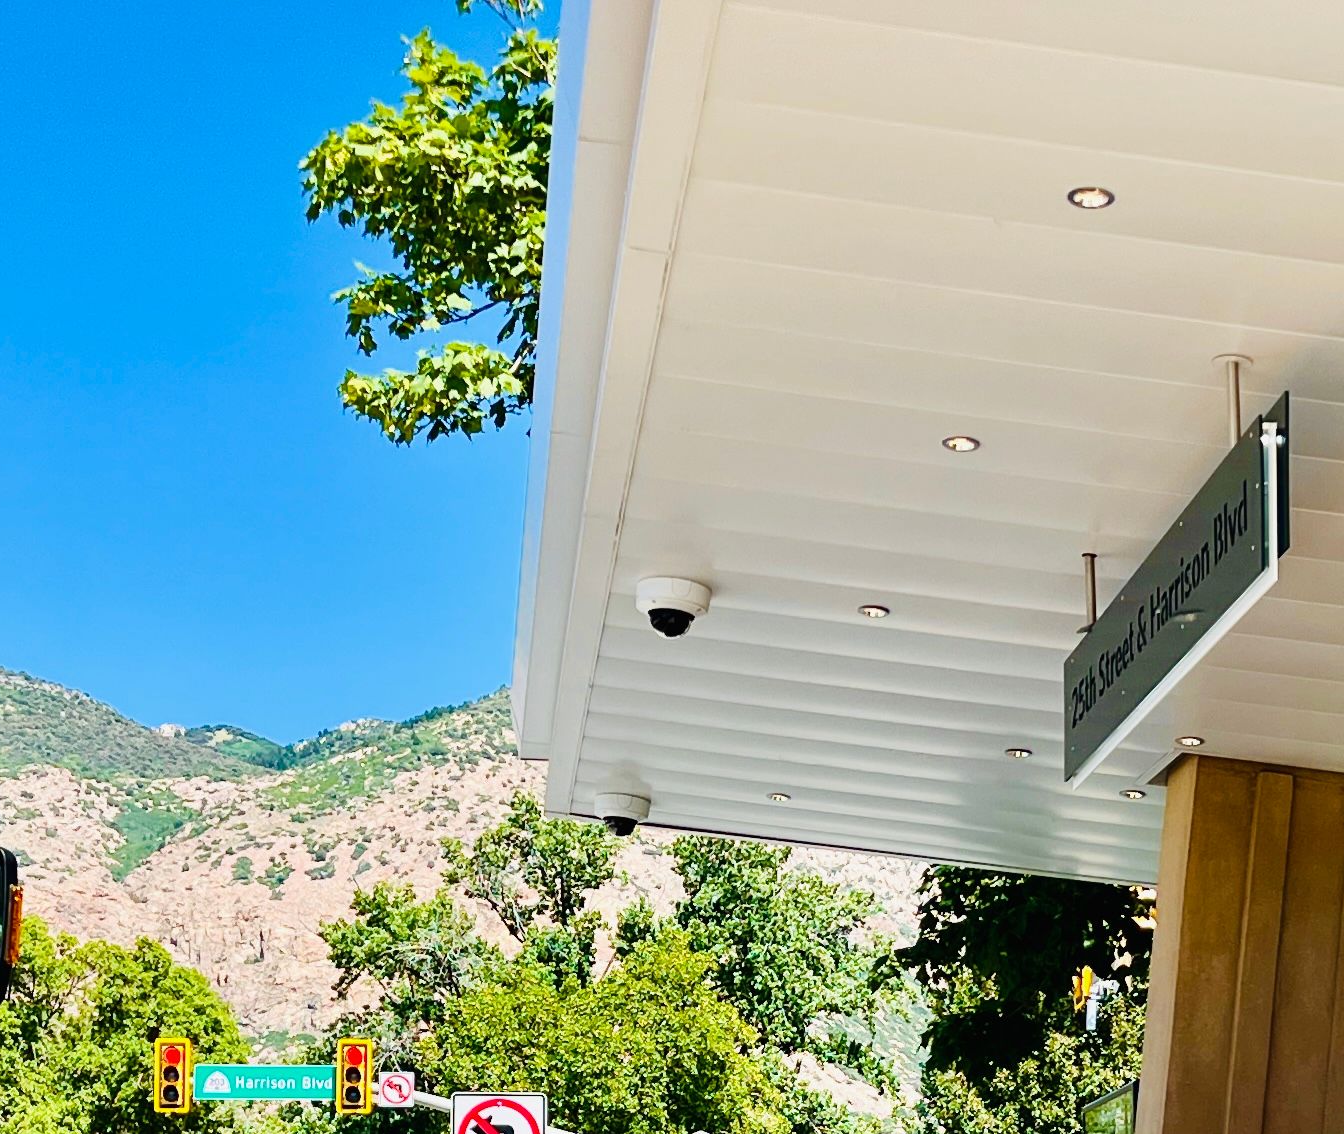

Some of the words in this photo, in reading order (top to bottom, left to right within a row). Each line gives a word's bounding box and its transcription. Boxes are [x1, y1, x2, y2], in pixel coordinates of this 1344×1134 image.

[1071, 665, 1097, 729] 25th
[1098, 622, 1134, 697] Street
[1136, 605, 1148, 653] &
[1150, 542, 1210, 639] Harrison
[1213, 480, 1248, 566] Blvd
[235, 1075, 296, 1090] Harrison
[301, 1075, 333, 1090] Blvd
